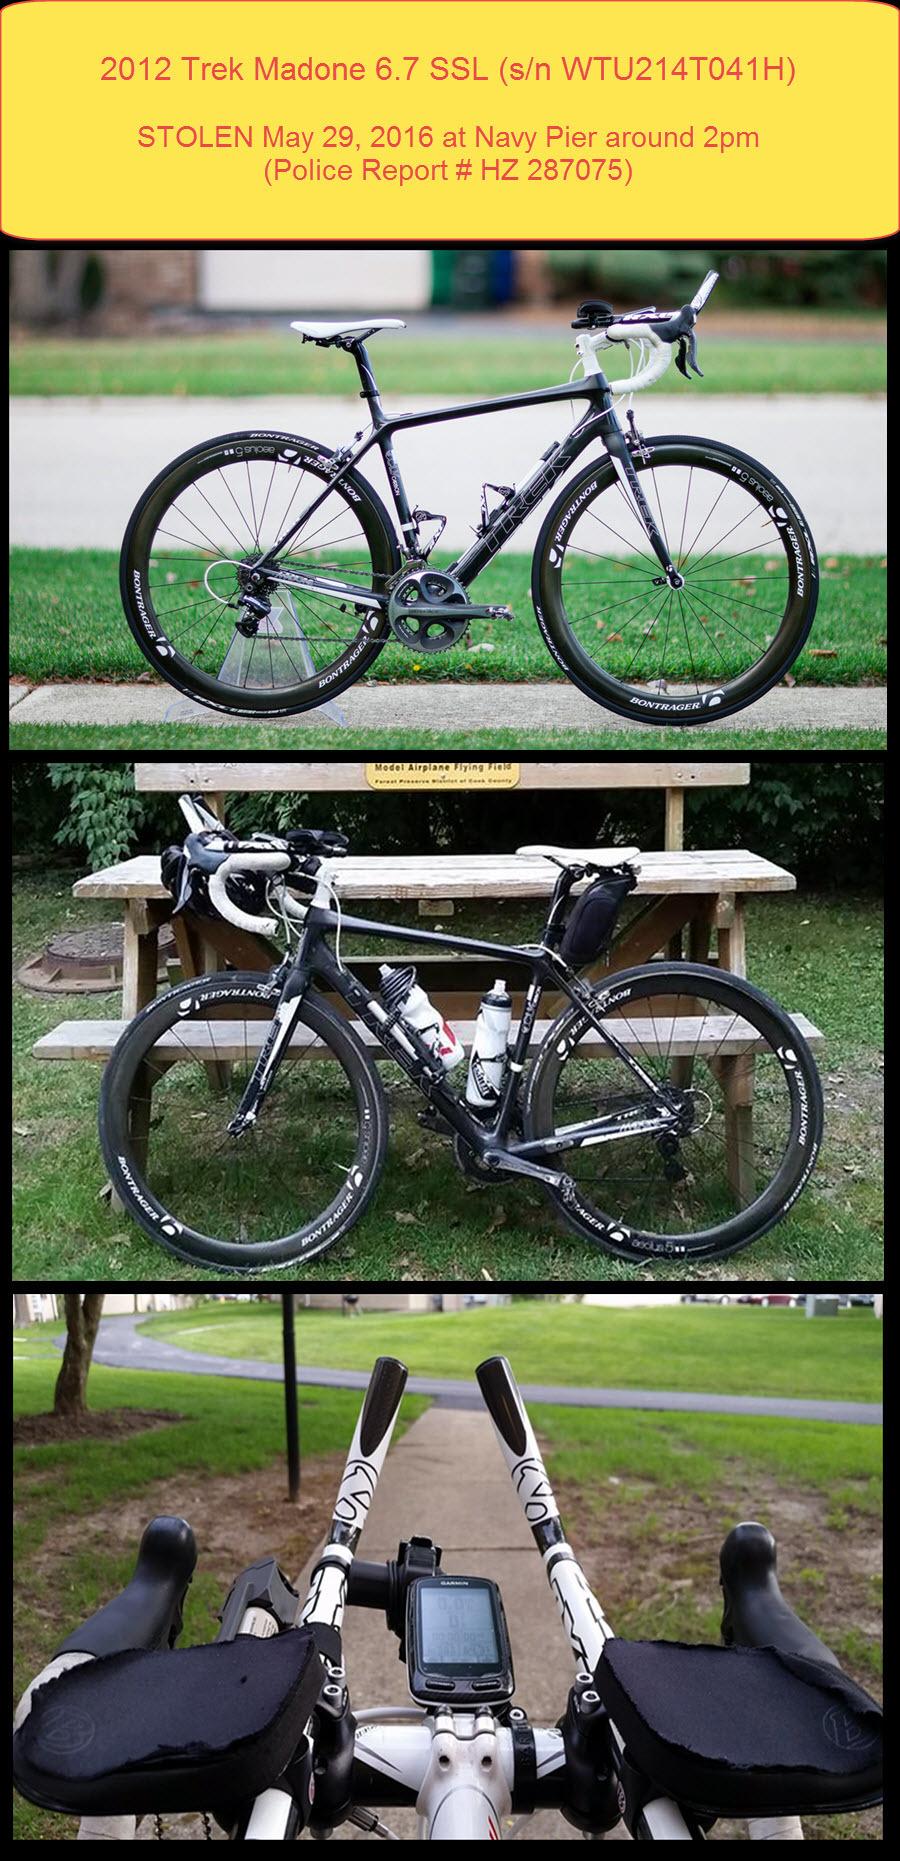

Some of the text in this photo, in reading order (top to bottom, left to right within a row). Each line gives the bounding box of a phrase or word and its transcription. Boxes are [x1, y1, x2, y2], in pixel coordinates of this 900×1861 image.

[482, 454, 572, 553] TREK
[553, 480, 599, 543] BONTRAGER
[624, 467, 661, 537] TREK
[786, 525, 805, 598] BONTRAGER
[133, 568, 157, 641] BONTRAGER
[629, 696, 701, 712] BONTRAGER
[375, 763, 404, 772] Model
[408, 763, 449, 773] Airplane
[454, 763, 484, 773] Flying
[794, 1070, 809, 1146] BONTRAGER
[117, 1156, 159, 1221] BONTRAGER
[301, 1191, 354, 1247] BONTRAGER
